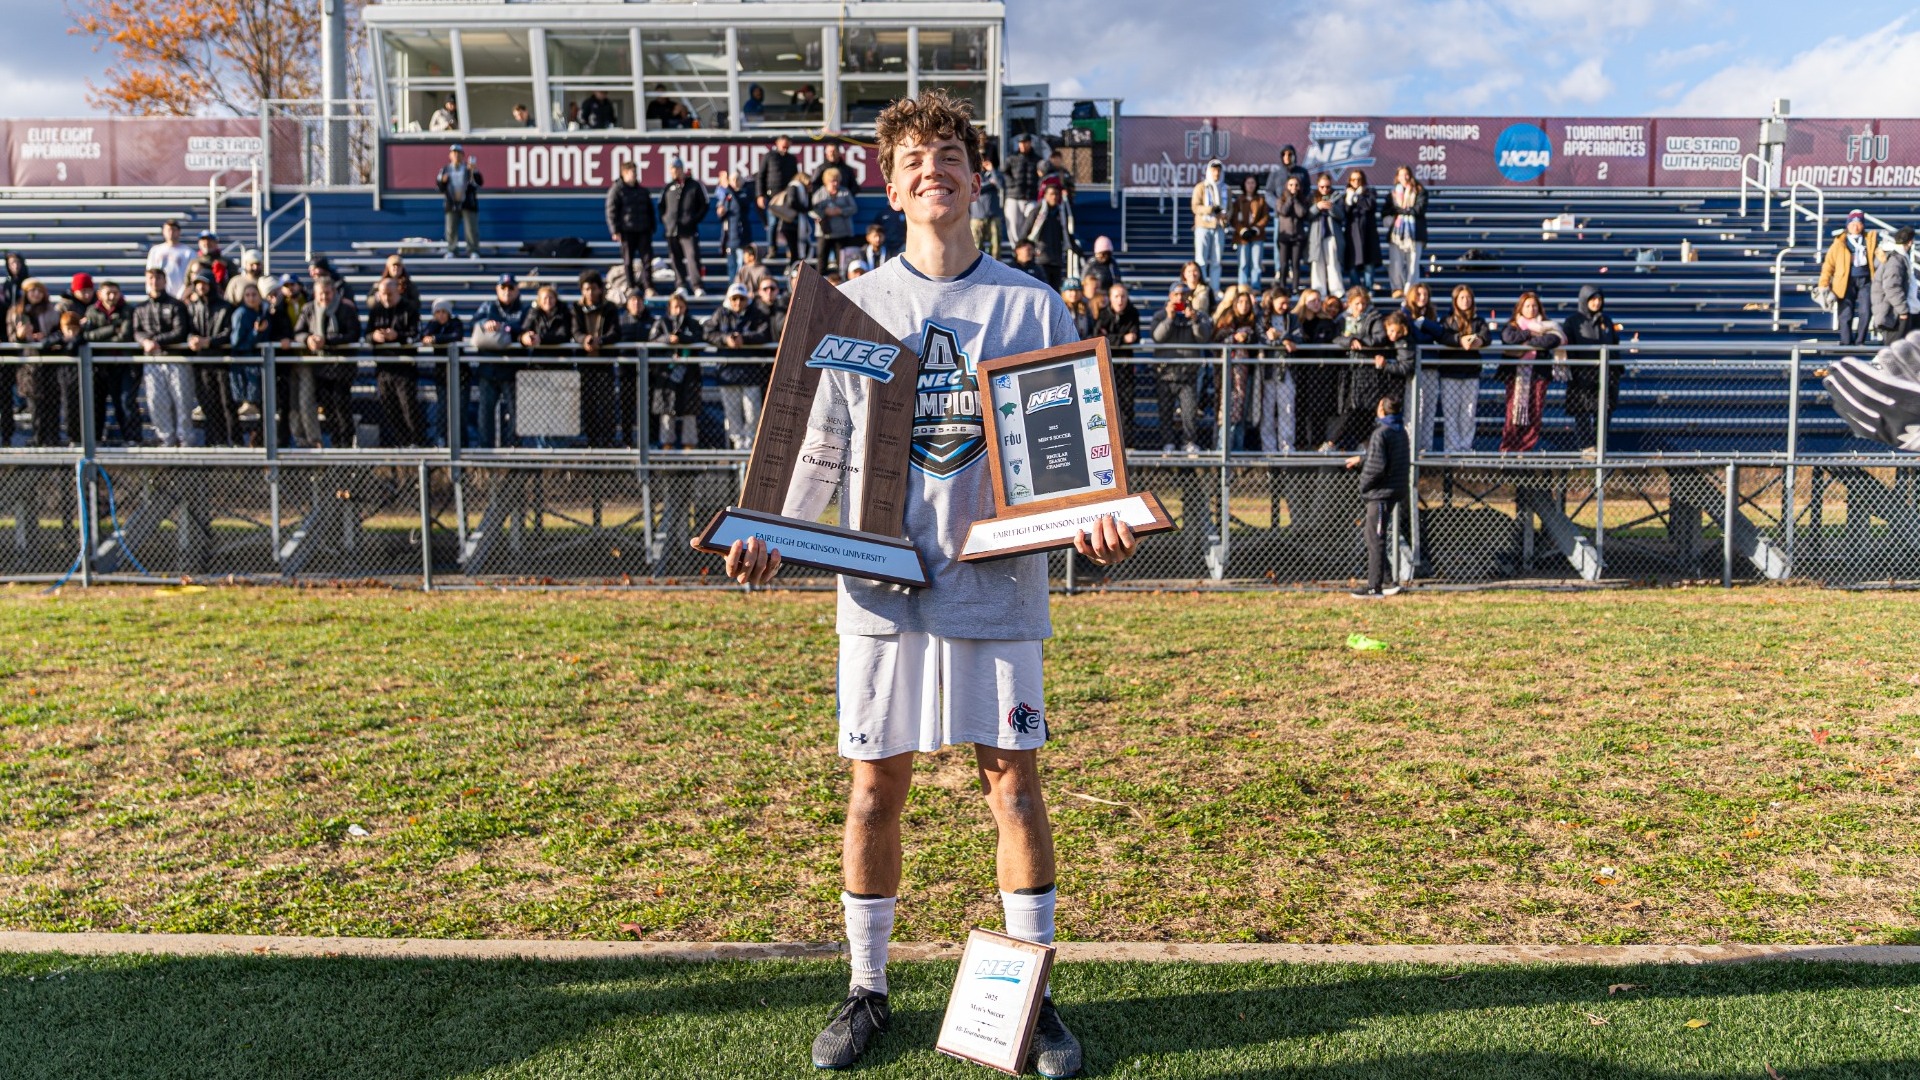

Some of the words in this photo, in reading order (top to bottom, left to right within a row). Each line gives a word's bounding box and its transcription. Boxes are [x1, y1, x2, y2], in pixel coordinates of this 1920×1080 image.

[28, 127, 59, 142] ELITE
[61, 127, 95, 142] EIGHT
[1385, 124, 1480, 140] CHAMPIONSHIPS
[1565, 125, 1644, 141] TOURNAMENT
[190, 139, 212, 151] WE
[215, 139, 262, 151] STAND
[1185, 130, 1230, 160] FDU
[1303, 133, 1376, 165] NEC
[1418, 145, 1446, 161] 2015
[1563, 141, 1646, 157] APPEARANCES
[1668, 138, 1690, 151] WE
[1693, 139, 1739, 152] STAND
[1847, 135, 1890, 163] FDU
[507, 145, 604, 187] HOME
[658, 145, 721, 186] THE
[1500, 150, 1550, 167] NCAA
[1664, 156, 1702, 168] WITH
[1703, 156, 1742, 169] PRIDE
[56, 162, 67, 181] 3
[1415, 165, 1447, 180] 2022
[1597, 162, 1608, 180] 2
[1785, 165, 1863, 186] WOMEN'S
[815, 336, 898, 369] NEC
[916, 369, 963, 390] NEC
[1028, 383, 1071, 409] NEC
[826, 416, 848, 427] MEN'S
[914, 425, 967, 435] 2025-26
[822, 425, 849, 436] SOCCER
[1004, 433, 1022, 447] FDU
[1091, 444, 1110, 460] SFU
[802, 454, 860, 474] Champions
[993, 526, 1031, 540] FAIRLEIGH
[1032, 518, 1076, 533] DICKINSON
[755, 532, 795, 547] FAIRLEIGH
[796, 540, 841, 555] DICKINSON
[842, 548, 888, 564] UNIVERSITY
[975, 959, 1025, 977] NEC
